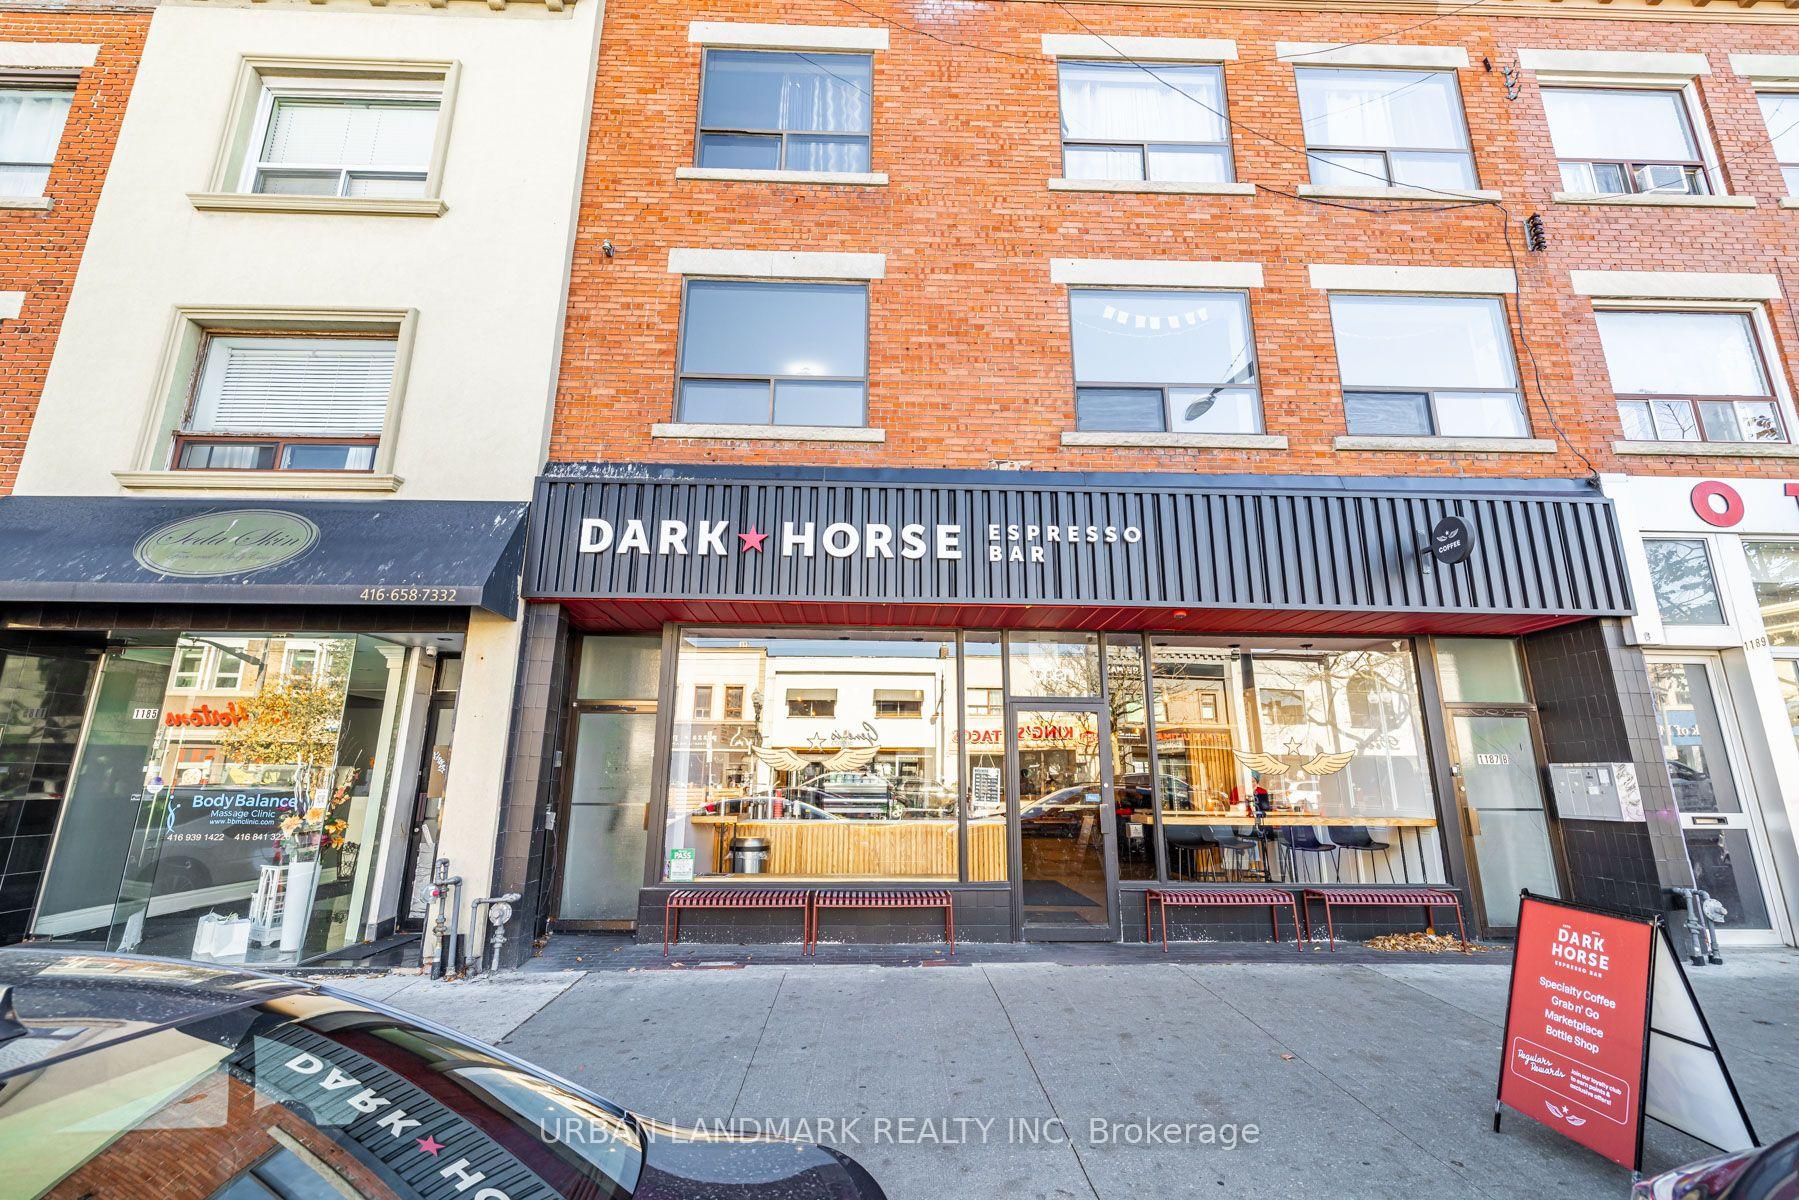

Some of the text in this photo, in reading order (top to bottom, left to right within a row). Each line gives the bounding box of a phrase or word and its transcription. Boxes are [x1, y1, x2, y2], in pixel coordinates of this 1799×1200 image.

[580, 518, 962, 560] DARK HORSE
[988, 524, 1141, 544] ESPRESSO
[988, 545, 1044, 563] BAR
[1438, 540, 1461, 553] COFFEE
[1744, 636, 1766, 651] 1189
[134, 709, 158, 719] 1185
[1478, 754, 1500, 764] 1187
[210, 809, 275, 819] Massage Clinic
[167, 833, 184, 841] 416
[204, 833, 224, 841] 1422
[234, 833, 250, 841] 416
[252, 833, 267, 841] 841
[674, 851, 692, 859] PASS
[1558, 928, 1605, 952] DARK
[1551, 942, 1610, 970] HORSE
[1554, 960, 1587, 974] ESPRESSO
[1539, 976, 1616, 1009] Specialty Coffee
[1551, 996, 1574, 1011] Grab
[1585, 1007, 1600, 1020] Go
[1544, 1008, 1604, 1038] Marketplace
[1545, 1025, 1600, 1054] Bottle Shop
